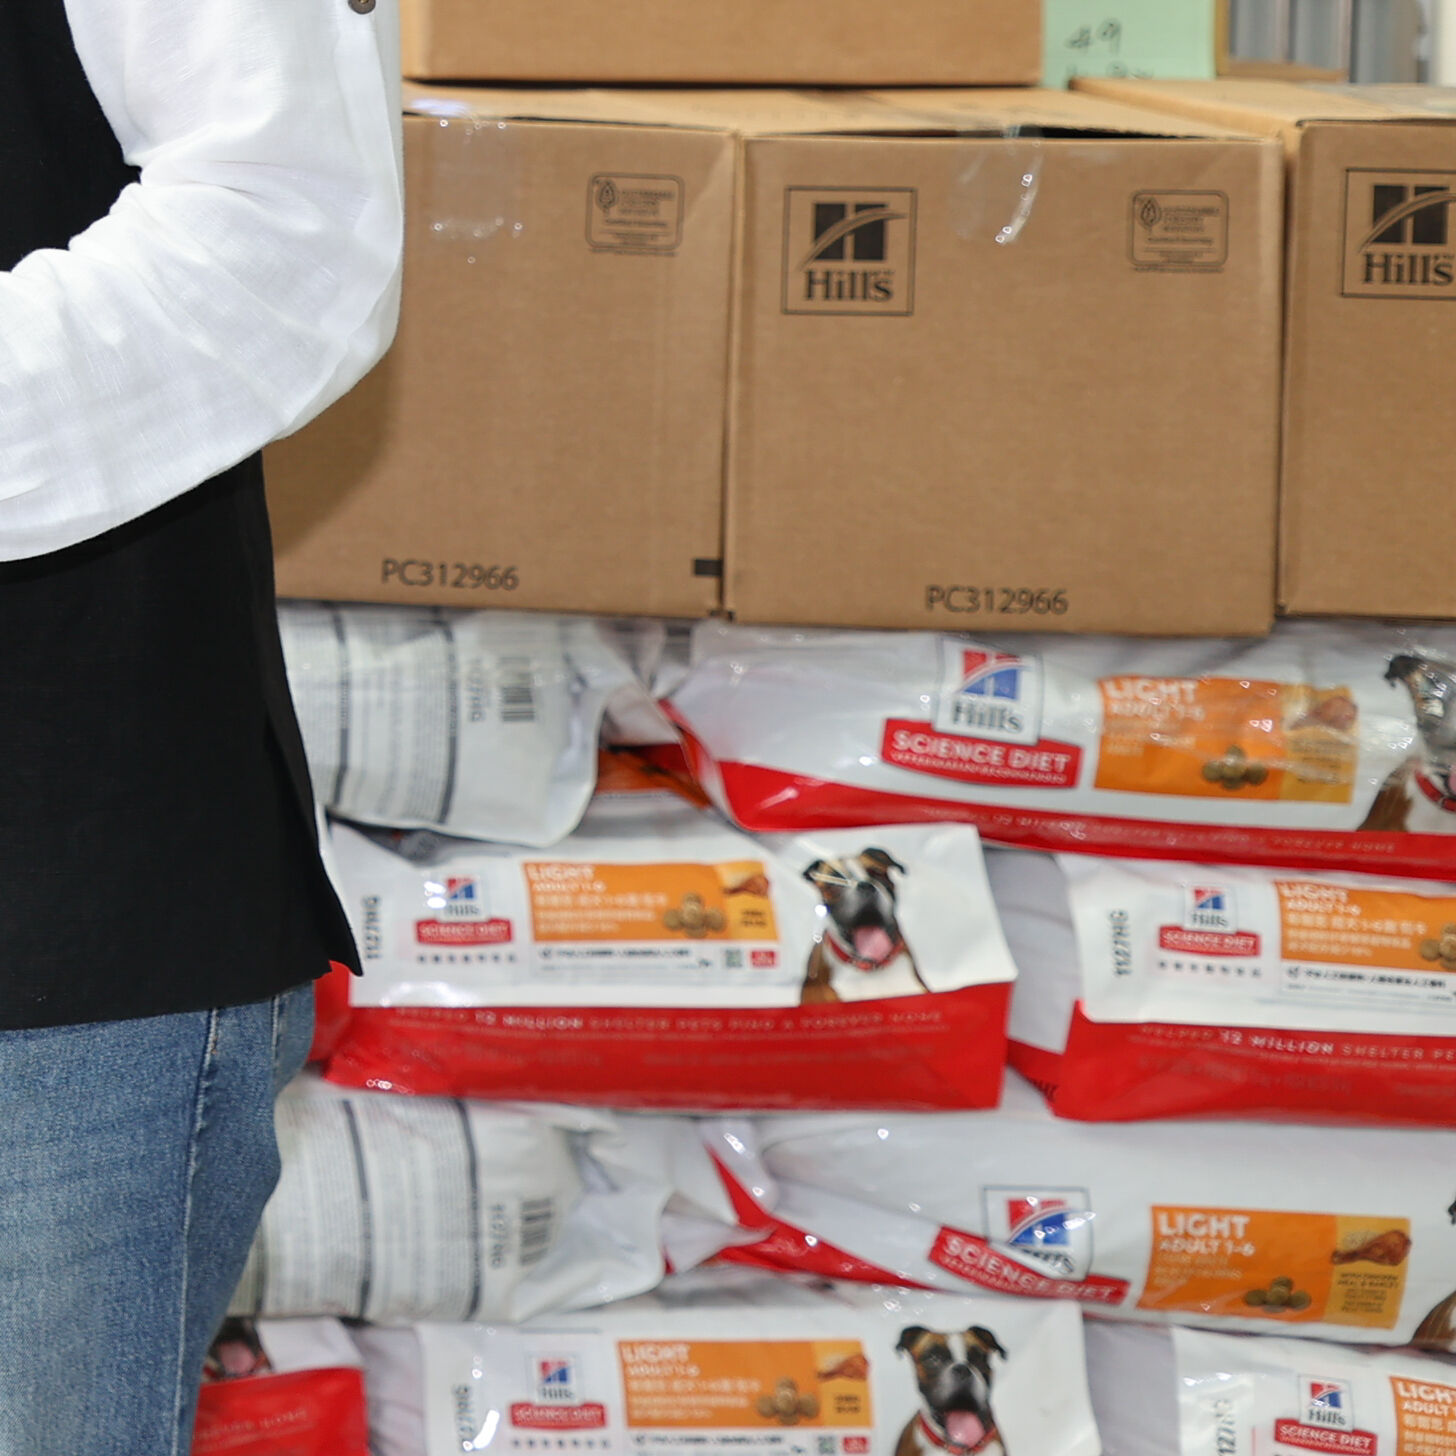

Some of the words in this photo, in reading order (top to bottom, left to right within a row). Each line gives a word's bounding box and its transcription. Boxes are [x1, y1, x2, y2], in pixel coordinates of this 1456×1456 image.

[381, 558, 520, 590] PC312966
[925, 585, 1069, 615] PC312966
[1103, 679, 1199, 703] LIGHT
[891, 728, 1005, 764] SCIENCE
[1009, 747, 1072, 772] DIET
[527, 865, 595, 881] LIGHT
[418, 923, 472, 937] SCIENCE
[1162, 931, 1220, 948] SCIENCE
[1223, 934, 1257, 950] DIET
[1251, 1035, 1335, 1055] MILLION
[1340, 1044, 1425, 1060] SHELTER
[1156, 1212, 1249, 1240] LIGHT
[1159, 1238, 1221, 1254] ADULT
[943, 1236, 1051, 1295] SCIENCE
[1057, 1281, 1114, 1302] DIET
[623, 1344, 690, 1362] LIGHT
[1308, 1409, 1347, 1426] Hill's
[1402, 1400, 1449, 1417] ADULT
[1280, 1424, 1338, 1443] SCIENCE
[1340, 1431, 1373, 1448] DIET
